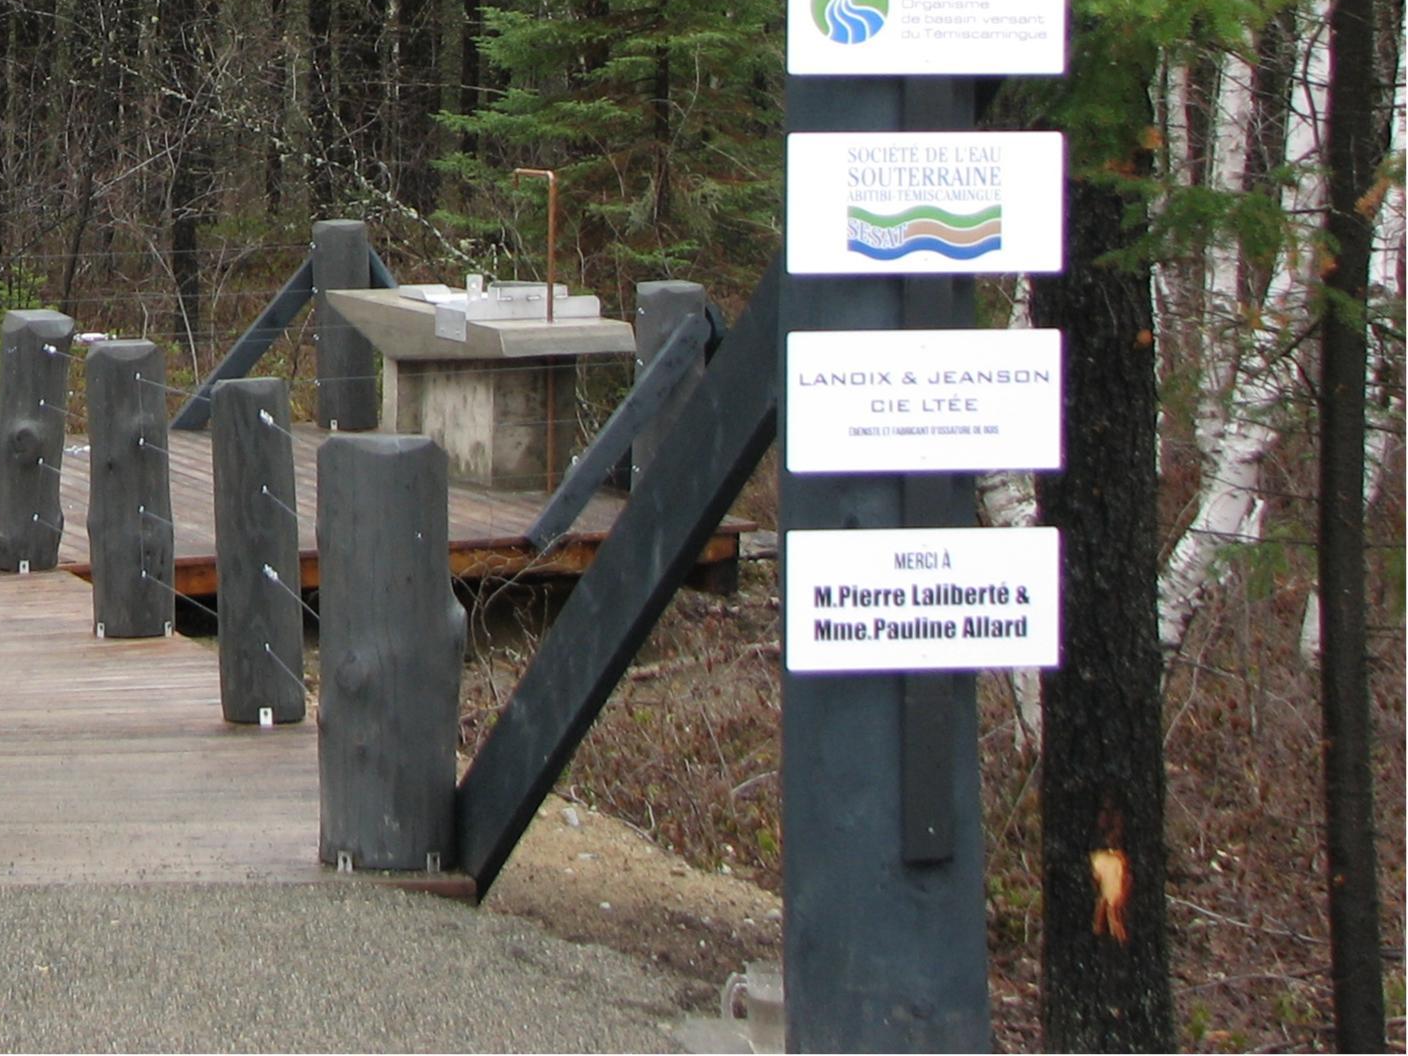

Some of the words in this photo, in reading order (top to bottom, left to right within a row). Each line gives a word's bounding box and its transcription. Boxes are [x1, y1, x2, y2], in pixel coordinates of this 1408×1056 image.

[901, 14, 920, 24] de
[924, 14, 977, 25] bassin
[983, 14, 1045, 25] versant
[901, 29, 920, 40] du
[847, 142, 919, 164] SOCIÉTÉ
[925, 146, 948, 163] DE
[955, 146, 1002, 163] L'EAU
[847, 166, 1002, 187] SOUTERRAINE
[847, 219, 907, 248] SESAT
[799, 372, 891, 387] LANOIX
[902, 371, 918, 385] &
[928, 369, 1049, 384] JEANSON
[871, 399, 910, 413] CIE
[922, 393, 978, 412] LTÉE
[894, 552, 938, 570] MERCI
[941, 548, 951, 569] À
[813, 585, 905, 608] M.Pierre
[912, 582, 1009, 606] Laliberté
[1016, 585, 1030, 604] &
[962, 616, 1027, 639] Allard
